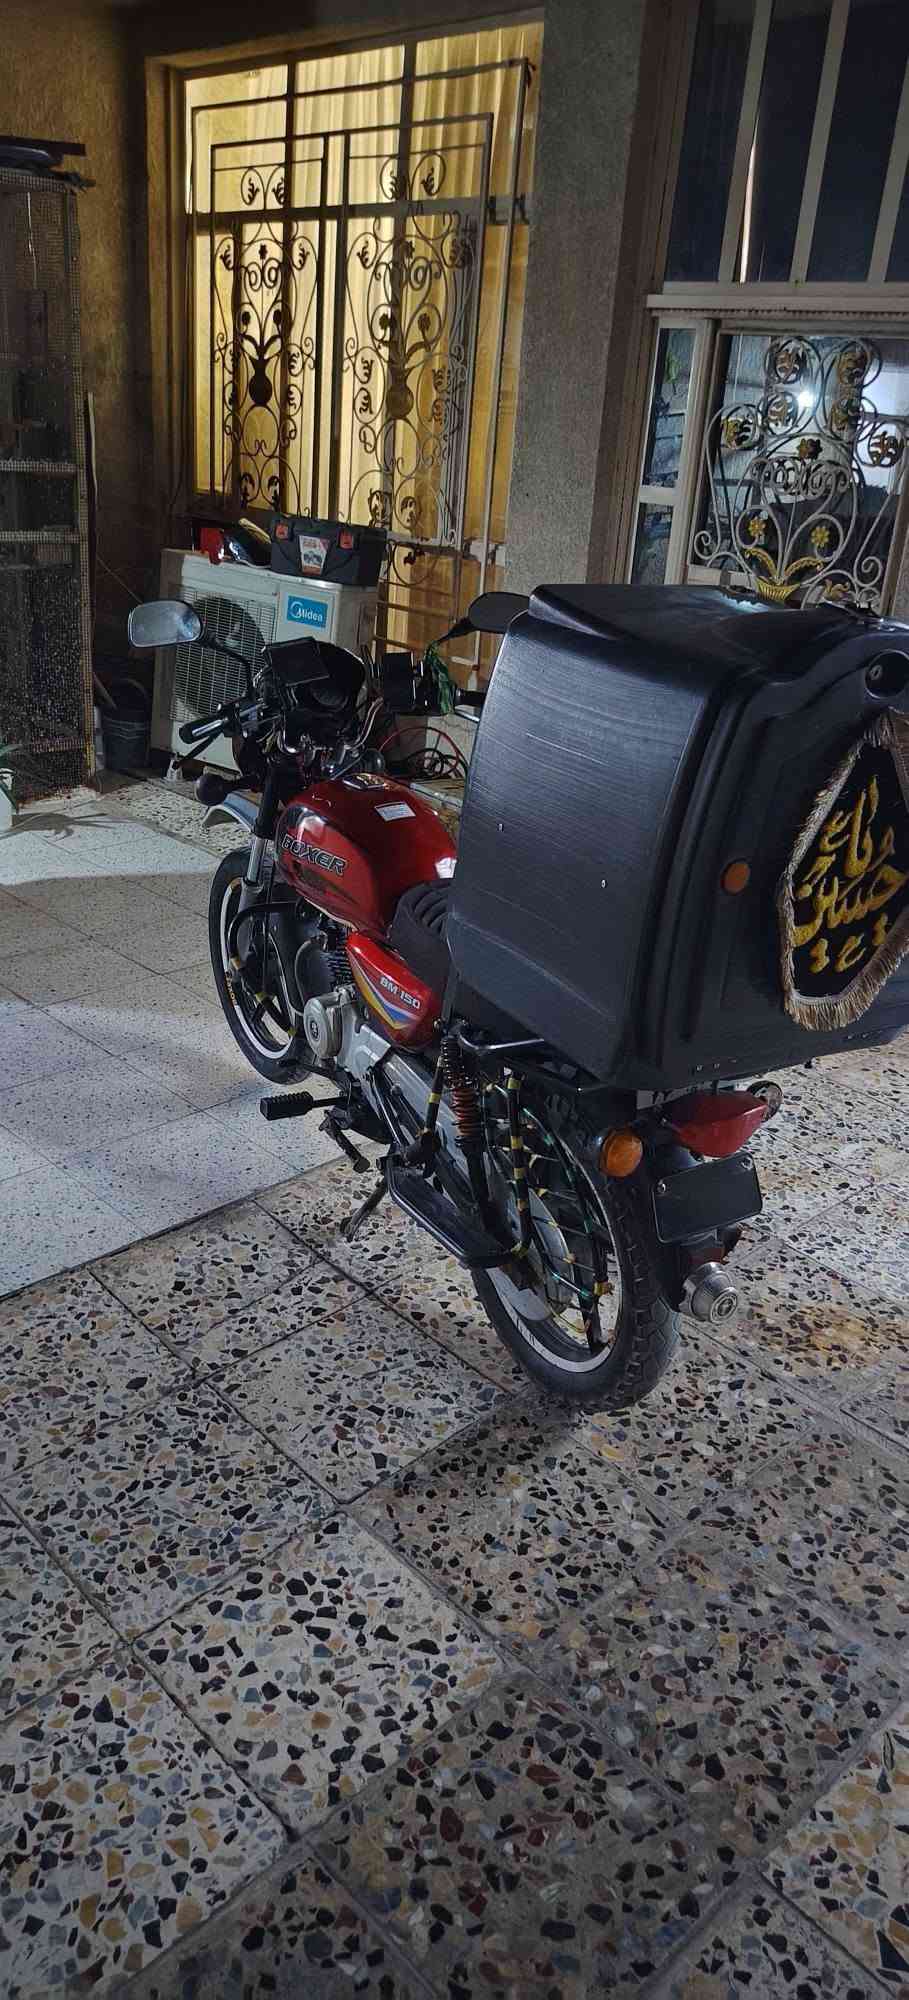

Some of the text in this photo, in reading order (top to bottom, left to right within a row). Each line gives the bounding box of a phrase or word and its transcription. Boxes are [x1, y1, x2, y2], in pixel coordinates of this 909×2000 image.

[295, 607, 323, 622] Midea
[281, 834, 347, 876] BOXER
[380, 977, 420, 1009] BM 150
